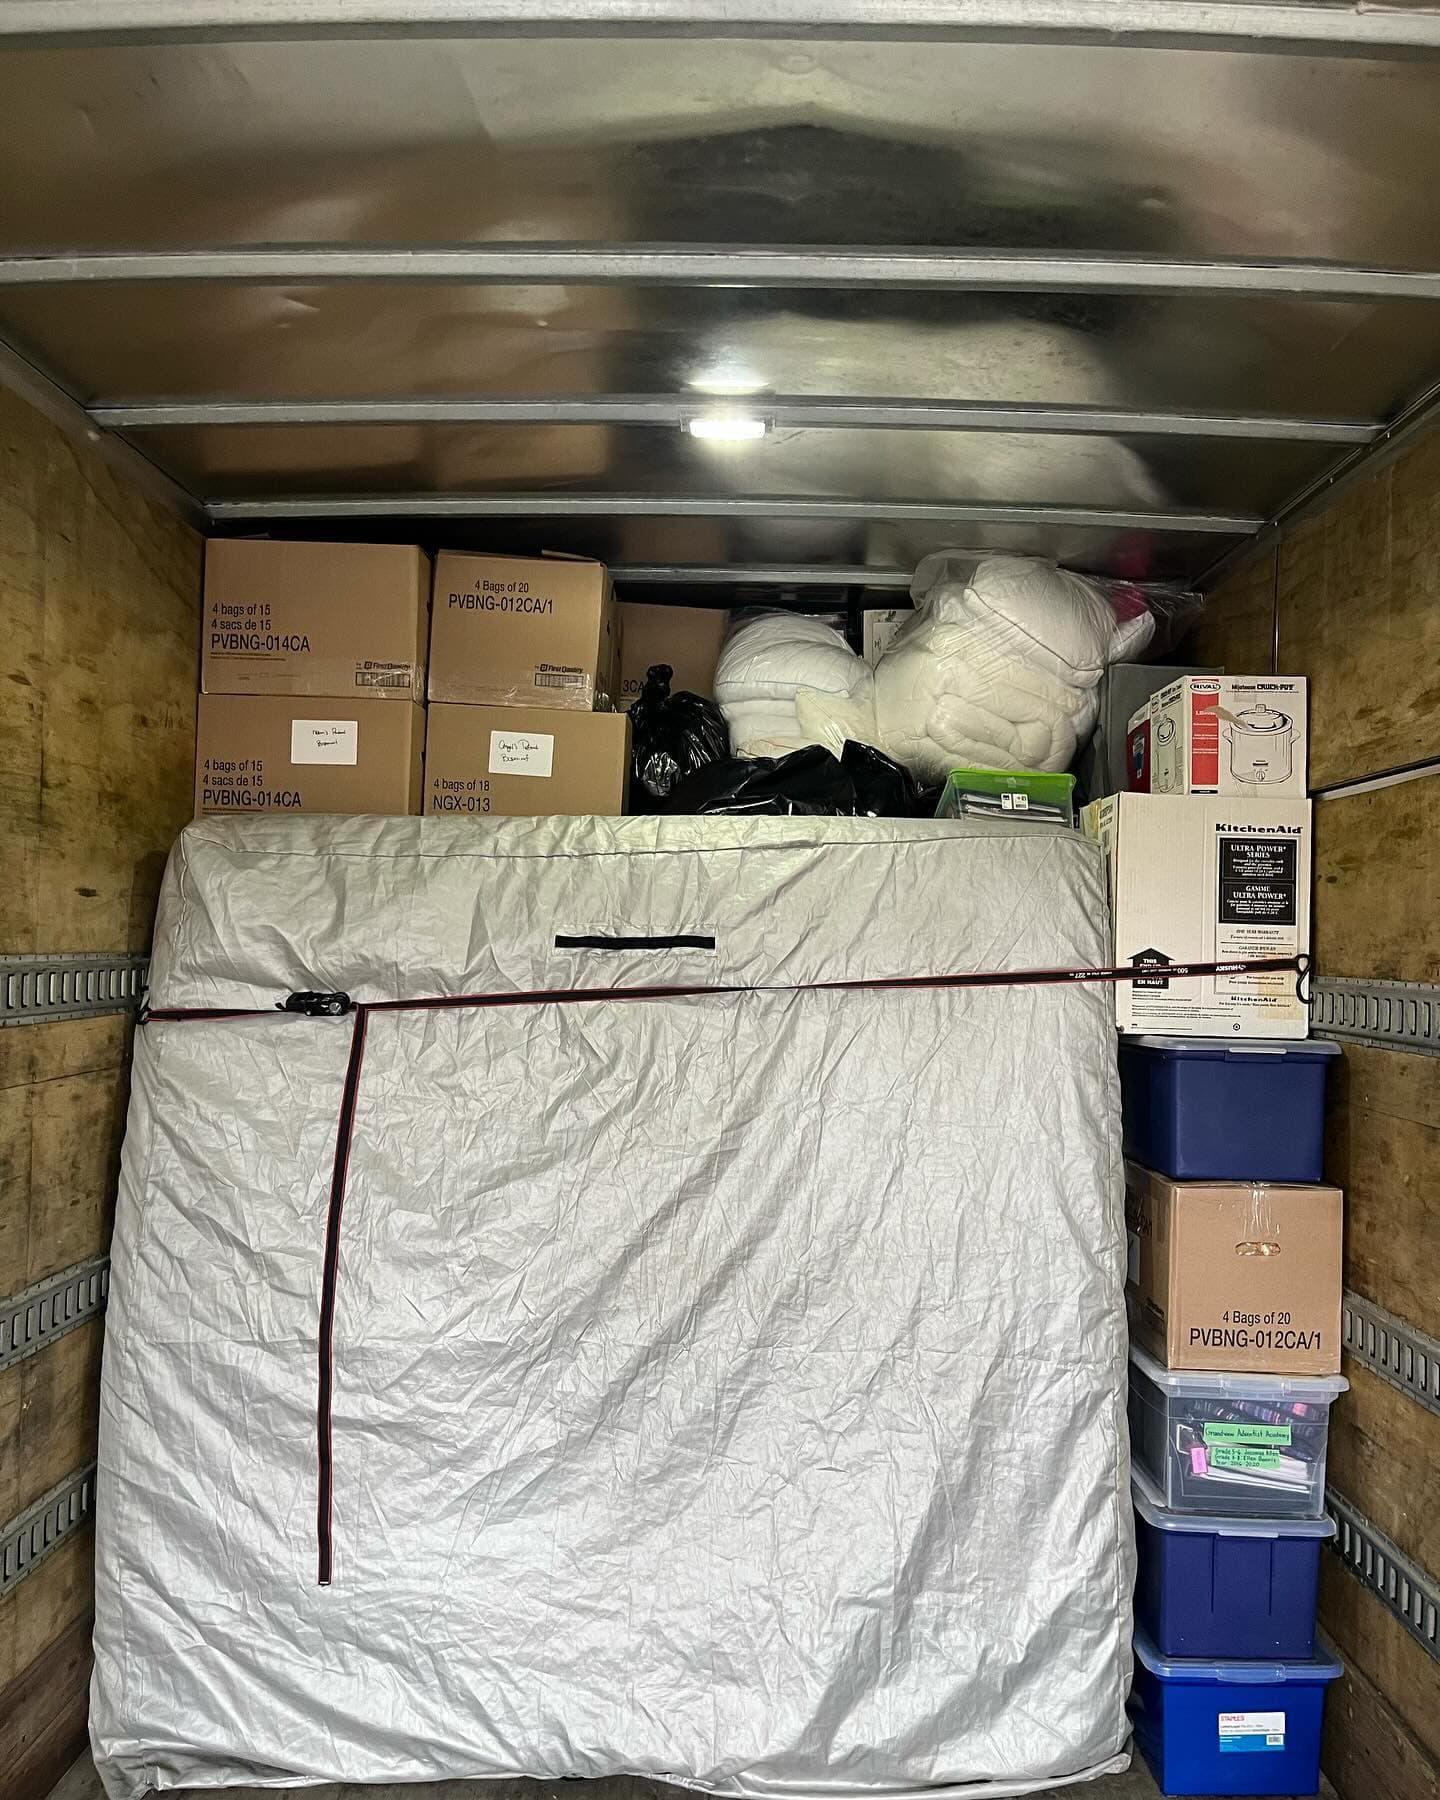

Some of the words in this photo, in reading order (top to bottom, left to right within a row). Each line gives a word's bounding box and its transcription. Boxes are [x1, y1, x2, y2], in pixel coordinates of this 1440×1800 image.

[475, 581, 480, 591] 4
[483, 580, 504, 593] Bags
[507, 581, 516, 592] of
[518, 582, 529, 593] 20
[212, 604, 218, 614] 4
[221, 603, 244, 616] bags
[247, 603, 257, 615] of
[259, 604, 271, 615] 15
[448, 594, 553, 614] PVBNG-012CA/1
[211, 619, 218, 629] 4
[220, 621, 242, 630] sacs
[245, 619, 257, 630] de
[260, 620, 271, 630] 15
[211, 634, 310, 652] PVBNG-014CA
[204, 760, 210, 770] 4
[212, 759, 236, 773] bags
[239, 759, 249, 771] of
[251, 760, 263, 771] 15
[203, 775, 210, 786] 4
[211, 777, 234, 786] sacs
[236, 775, 248, 786] de
[251, 776, 263, 787] 15
[434, 779, 440, 789] 4
[442, 779, 464, 792] bags
[467, 779, 477, 790] of
[480, 780, 490, 791] 18
[203, 790, 302, 808] PVBNG-014CA
[433, 795, 490, 812] NGX-013
[1215, 823, 1302, 834] KitchenAid
[1231, 844, 1254, 852] ULTRA
[1222, 1311, 1229, 1323] 4
[1233, 1311, 1260, 1326] Bags
[1263, 1311, 1275, 1324] of
[1277, 1312, 1291, 1324] 20
[1190, 1328, 1321, 1350] PVBNG-012CA/1
